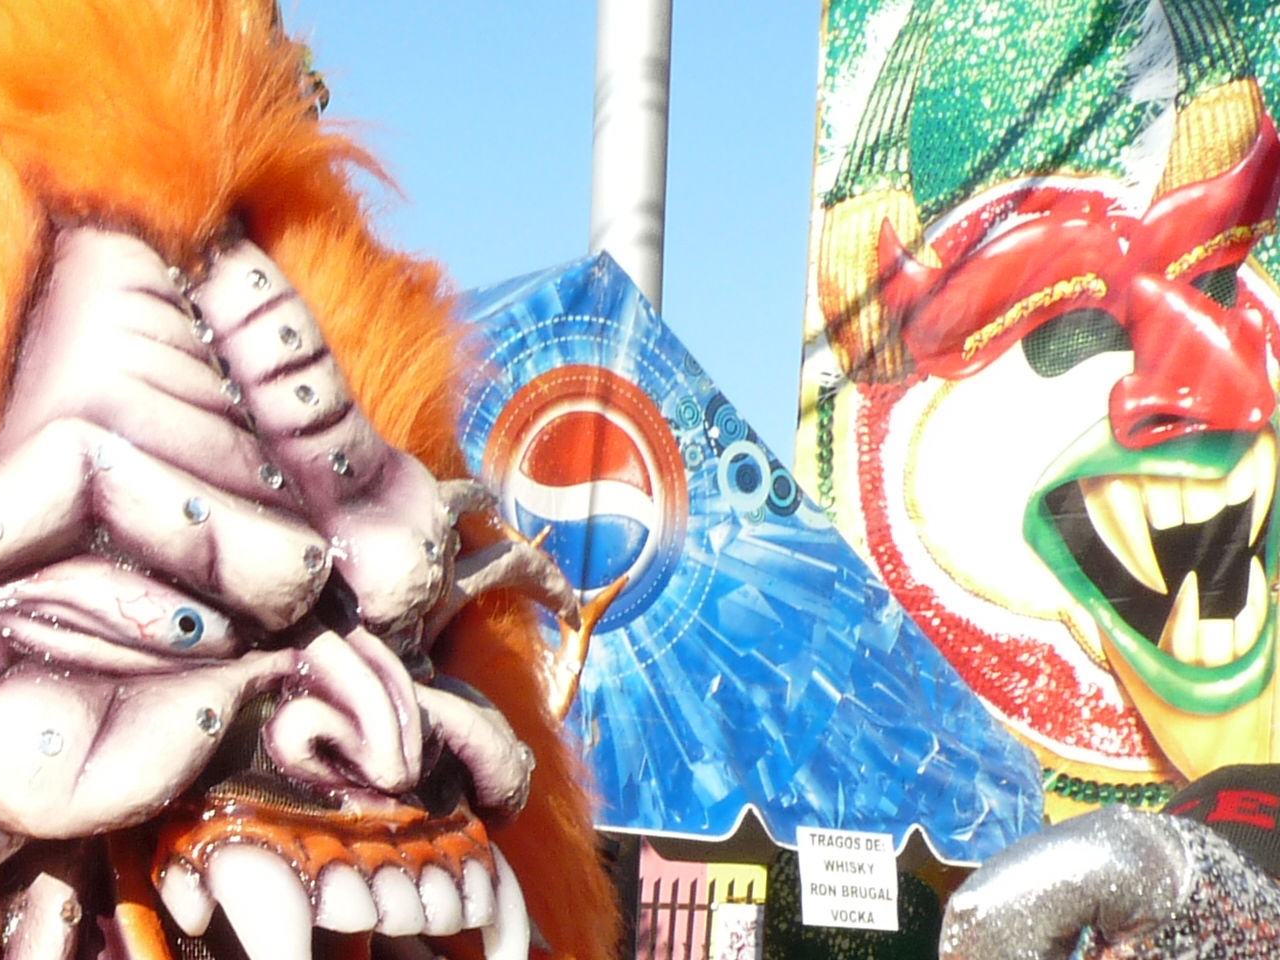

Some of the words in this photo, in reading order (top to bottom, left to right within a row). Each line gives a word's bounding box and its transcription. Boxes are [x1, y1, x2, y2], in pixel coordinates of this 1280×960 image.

[809, 833, 861, 850] TRAGOS
[824, 859, 874, 875] WHISKY
[810, 882, 837, 897] RON
[841, 885, 893, 901] BRUGAL
[831, 909, 875, 924] VOCKA
